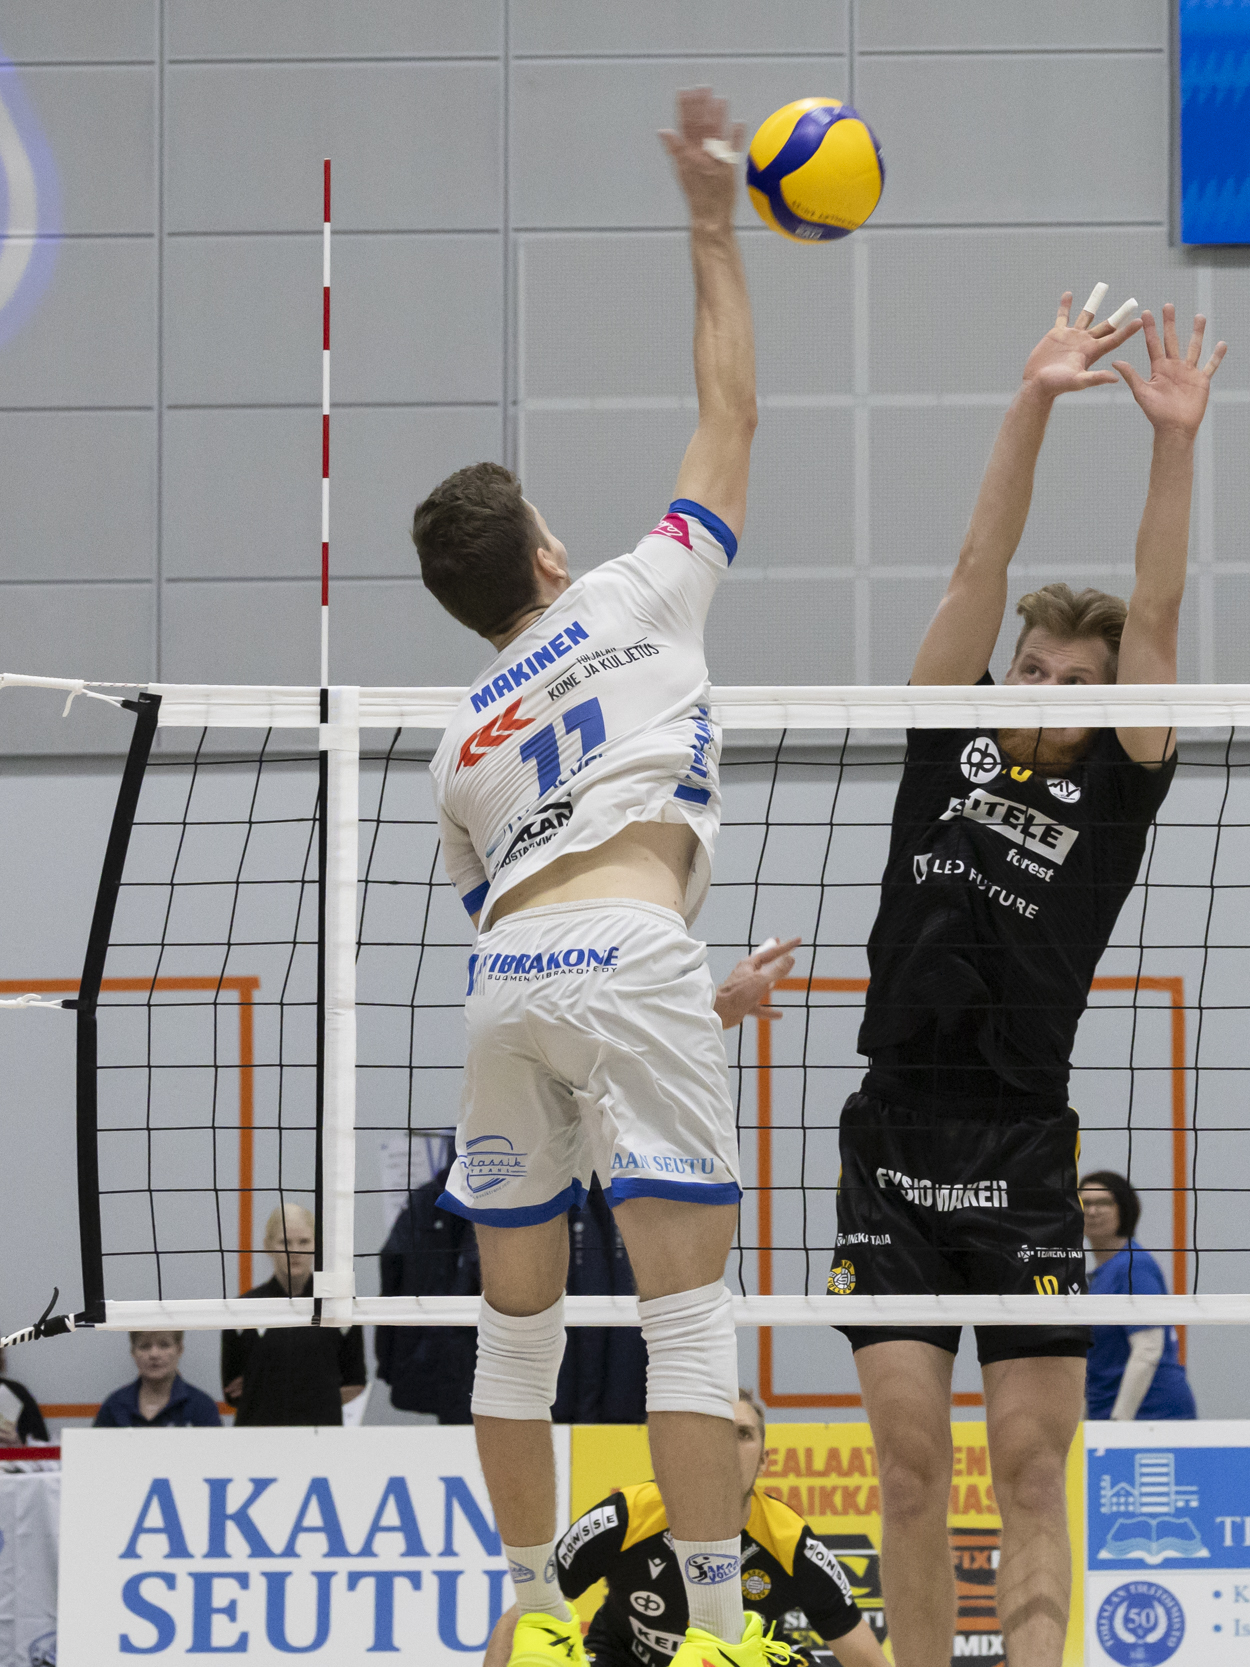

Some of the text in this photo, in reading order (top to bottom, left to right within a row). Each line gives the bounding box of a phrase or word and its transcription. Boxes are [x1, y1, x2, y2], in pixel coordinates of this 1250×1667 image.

[547, 643, 660, 701] KONE JA KULJETUS
[1006, 848, 1054, 882] forest
[968, 867, 1039, 919] FUTURE
[487, 974, 530, 982] SUOMEN
[653, 1155, 714, 1175] SEUTU
[119, 1476, 502, 1559] AKAAN
[119, 1570, 510, 1654] SEUTU
[1127, 1608, 1156, 1629] 50
